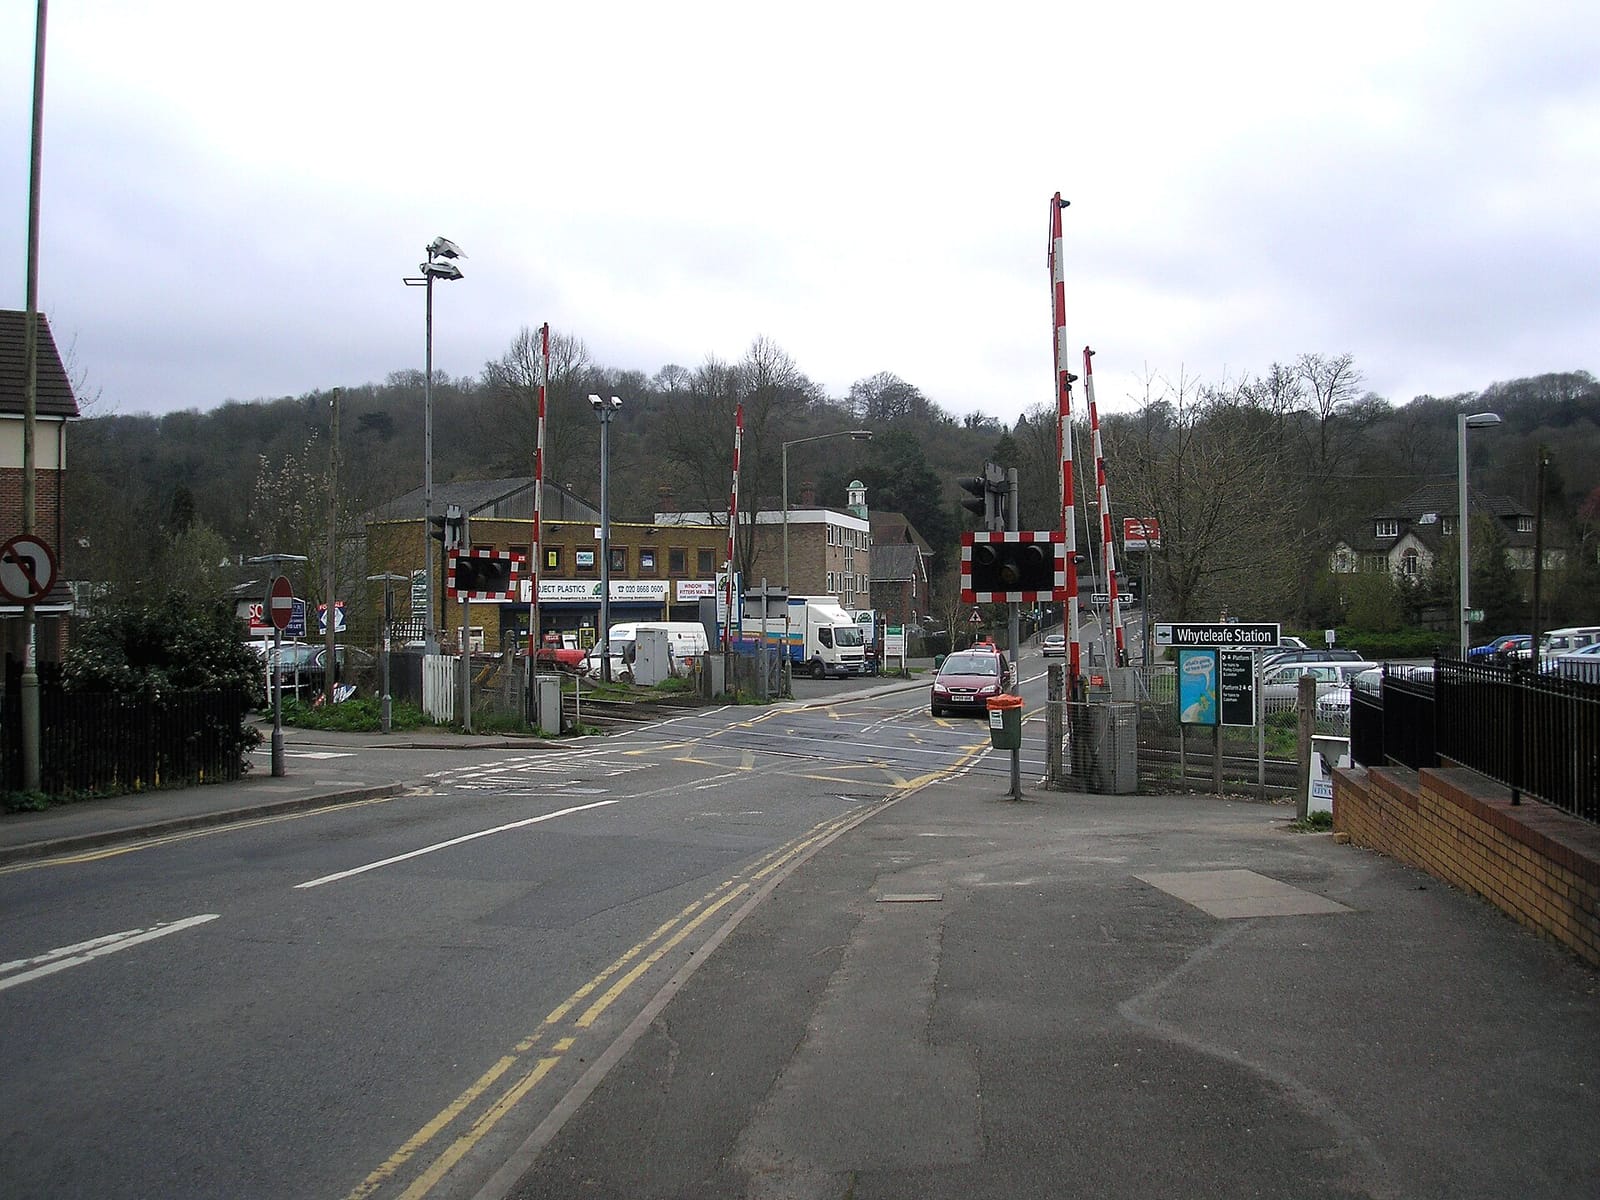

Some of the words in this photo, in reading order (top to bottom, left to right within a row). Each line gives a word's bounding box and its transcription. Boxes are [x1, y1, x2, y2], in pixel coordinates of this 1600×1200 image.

[528, 585, 555, 593] POJECT
[557, 585, 586, 593] PLASTICS
[626, 585, 635, 593] 020
[650, 585, 664, 593] 0600
[249, 604, 263, 617] SO
[1177, 629, 1232, 644] Whyteleafe
[1235, 629, 1271, 642] Station
